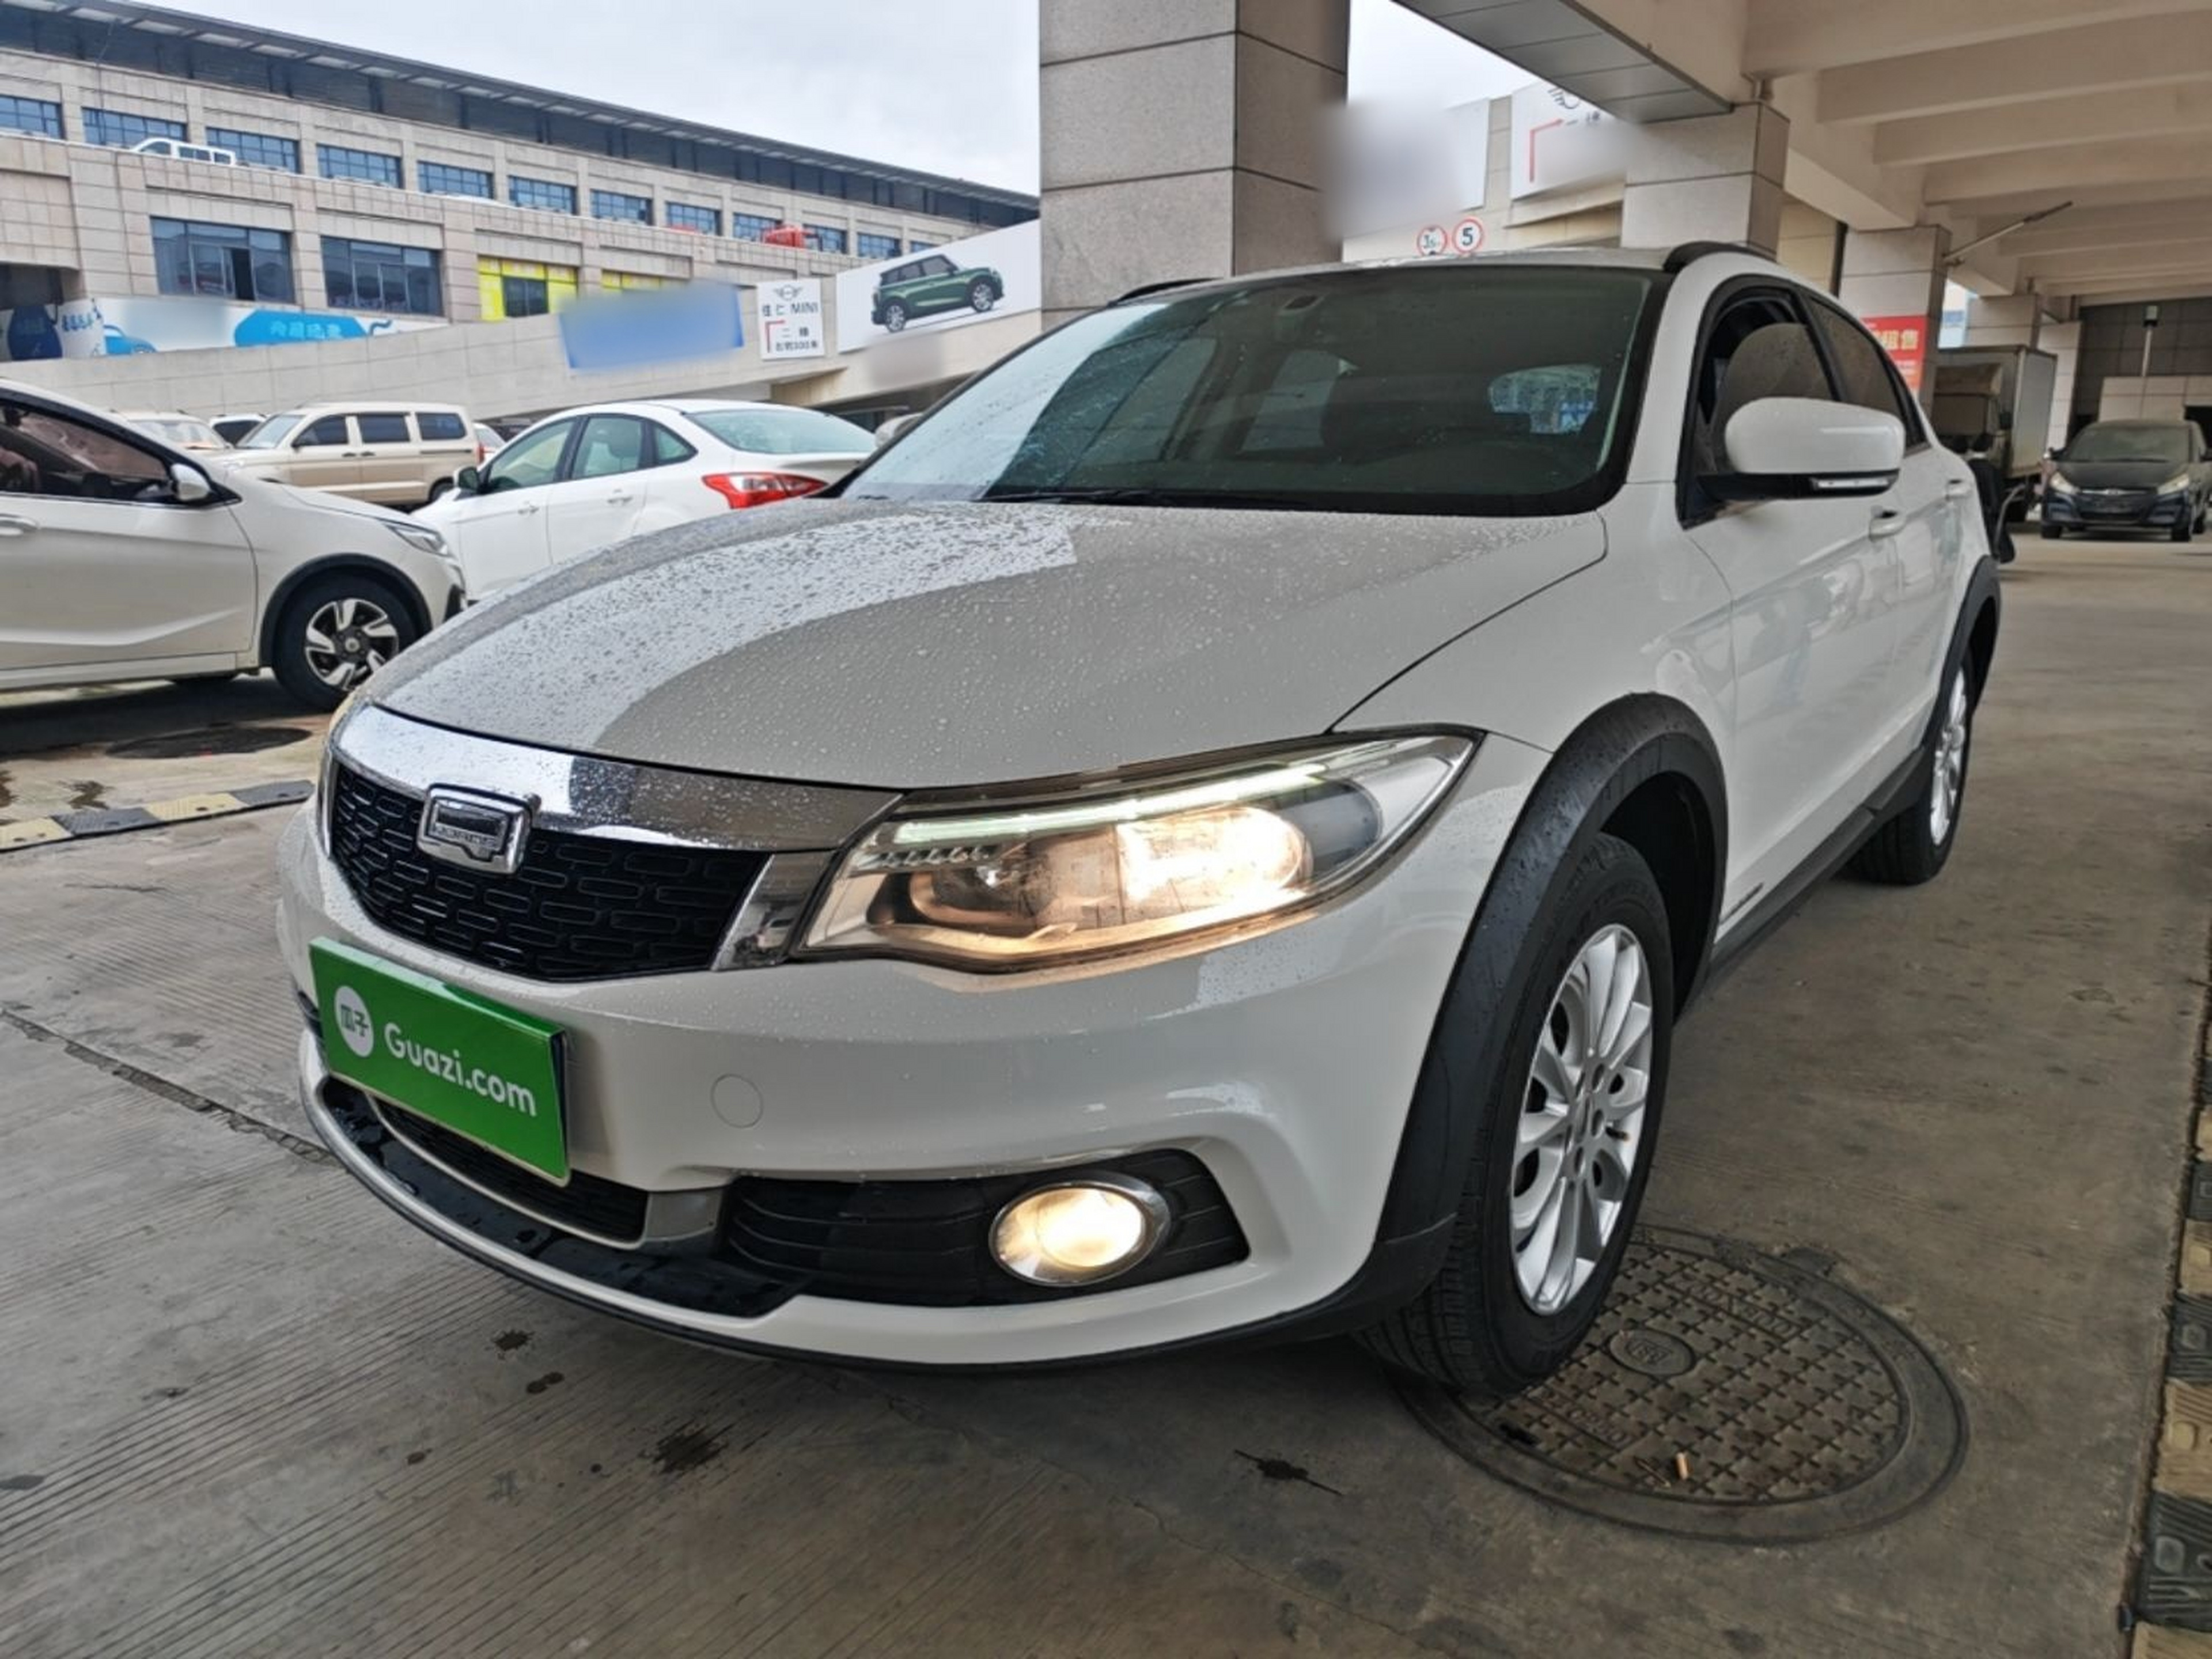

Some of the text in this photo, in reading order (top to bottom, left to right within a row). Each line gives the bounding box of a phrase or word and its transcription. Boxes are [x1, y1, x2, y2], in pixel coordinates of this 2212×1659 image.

[1463, 226, 1474, 247] 5
[790, 301, 819, 313] MINI
[340, 1003, 369, 1037] 瓜子
[384, 1022, 537, 1118] Guazi.com
